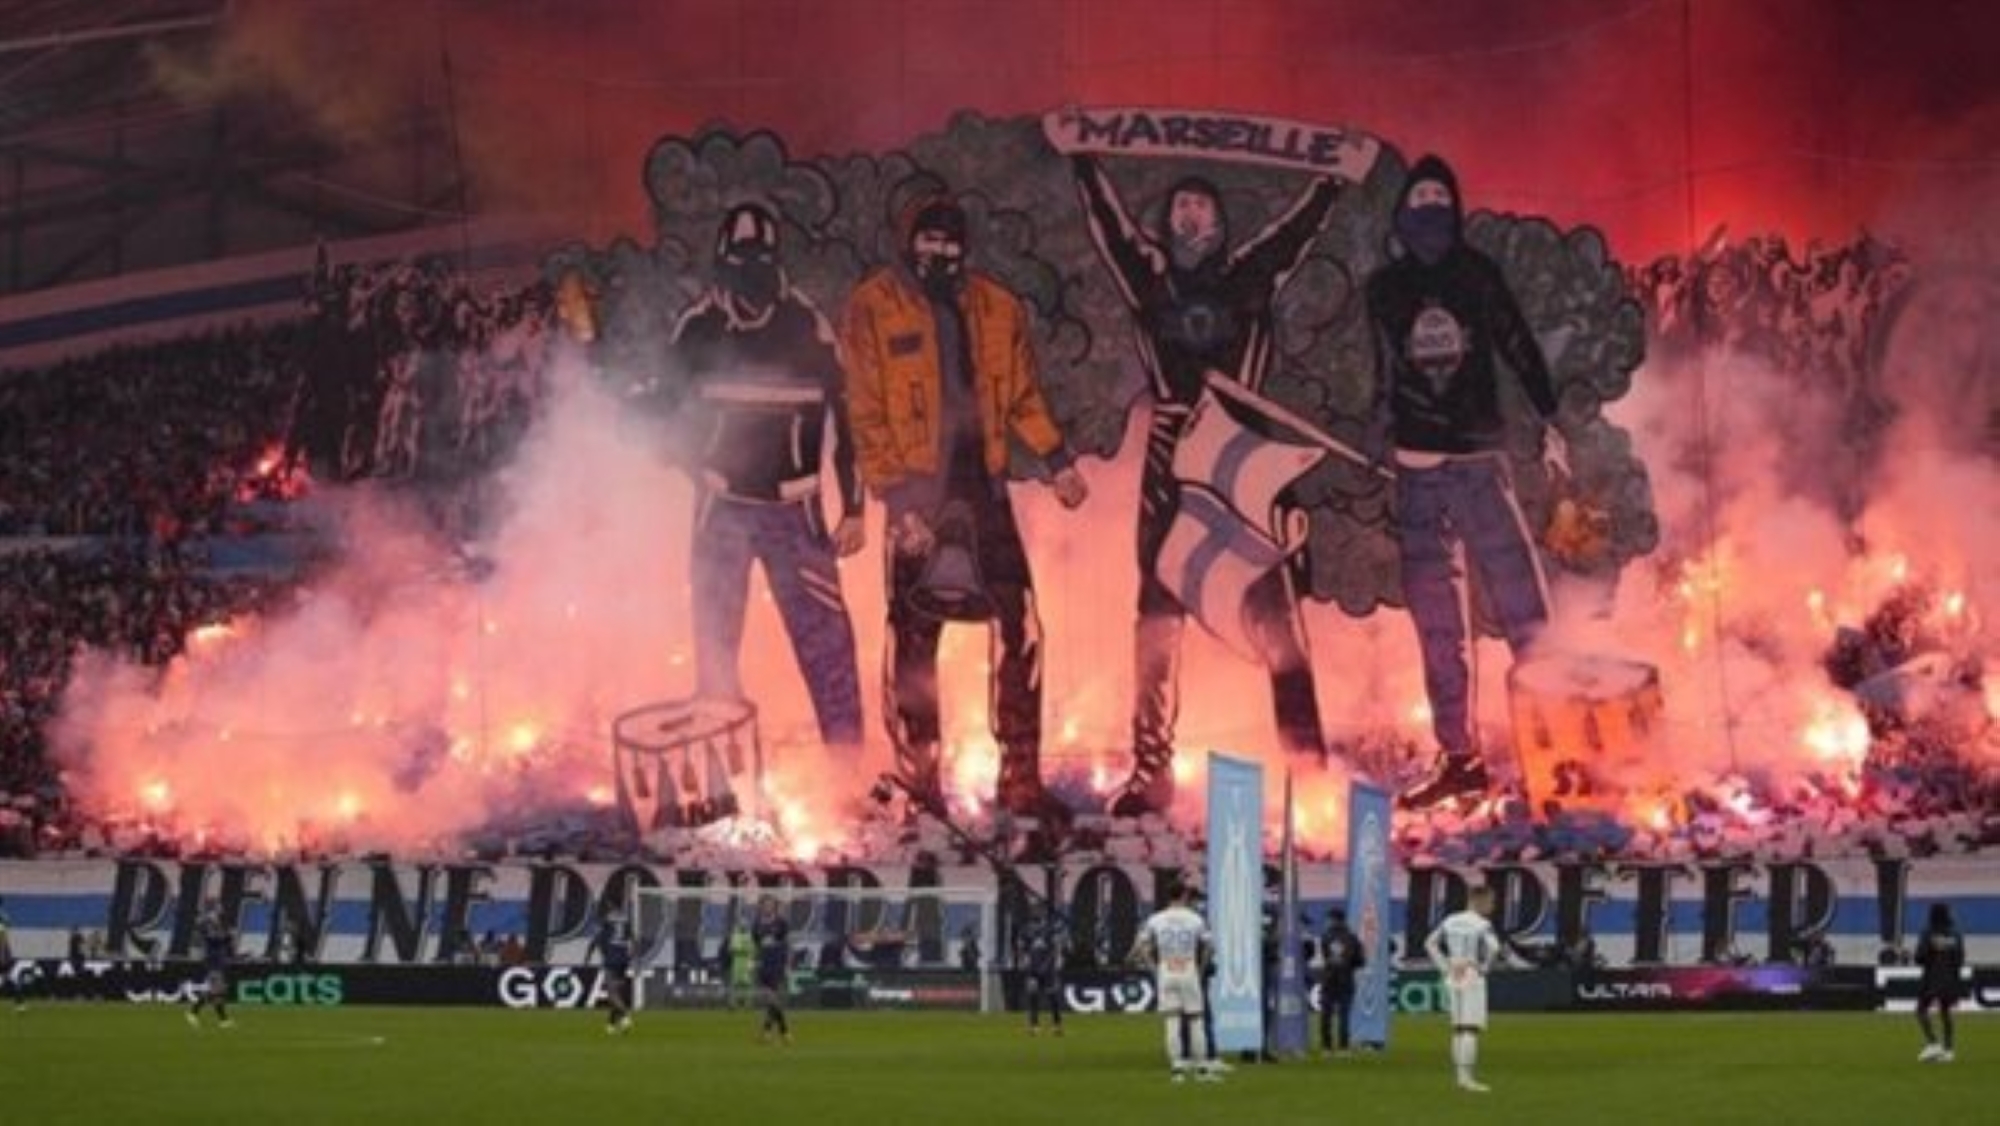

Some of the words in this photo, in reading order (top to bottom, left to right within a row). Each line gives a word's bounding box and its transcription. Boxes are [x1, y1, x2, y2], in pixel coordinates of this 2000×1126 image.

[1075, 112, 1341, 165] MARSEILLE
[104, 858, 344, 961] RIEN
[359, 854, 498, 962] NE
